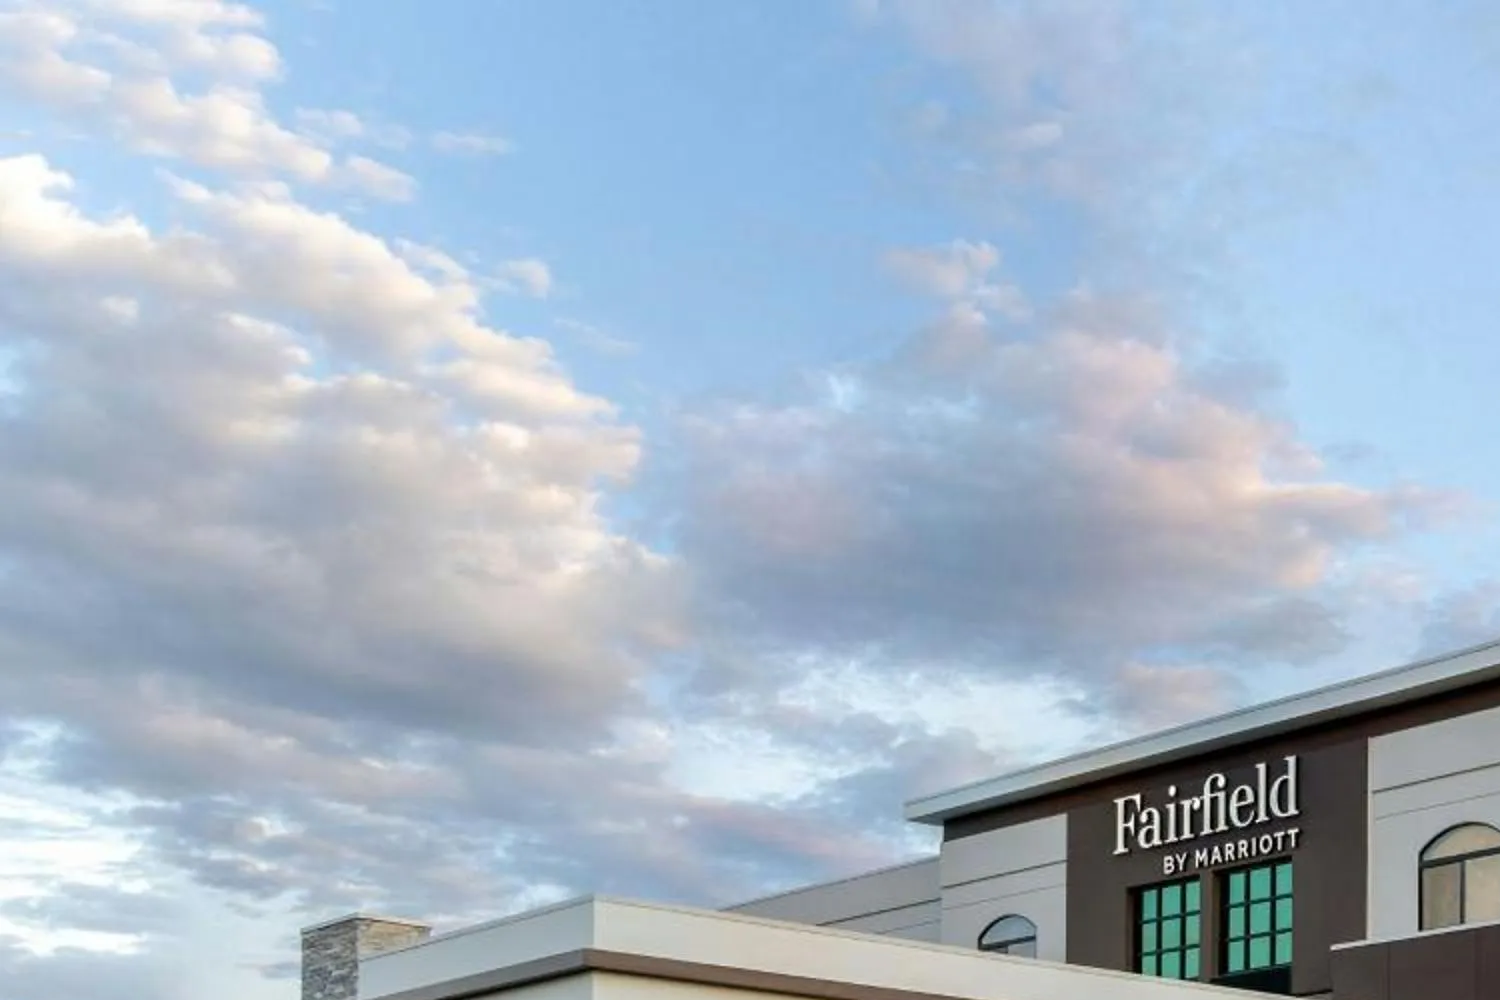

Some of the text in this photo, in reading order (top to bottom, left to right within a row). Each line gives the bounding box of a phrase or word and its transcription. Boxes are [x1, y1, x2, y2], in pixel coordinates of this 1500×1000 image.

[1112, 755, 1299, 855] Fairfield
[1163, 828, 1299, 875] BY MARRIOTT
